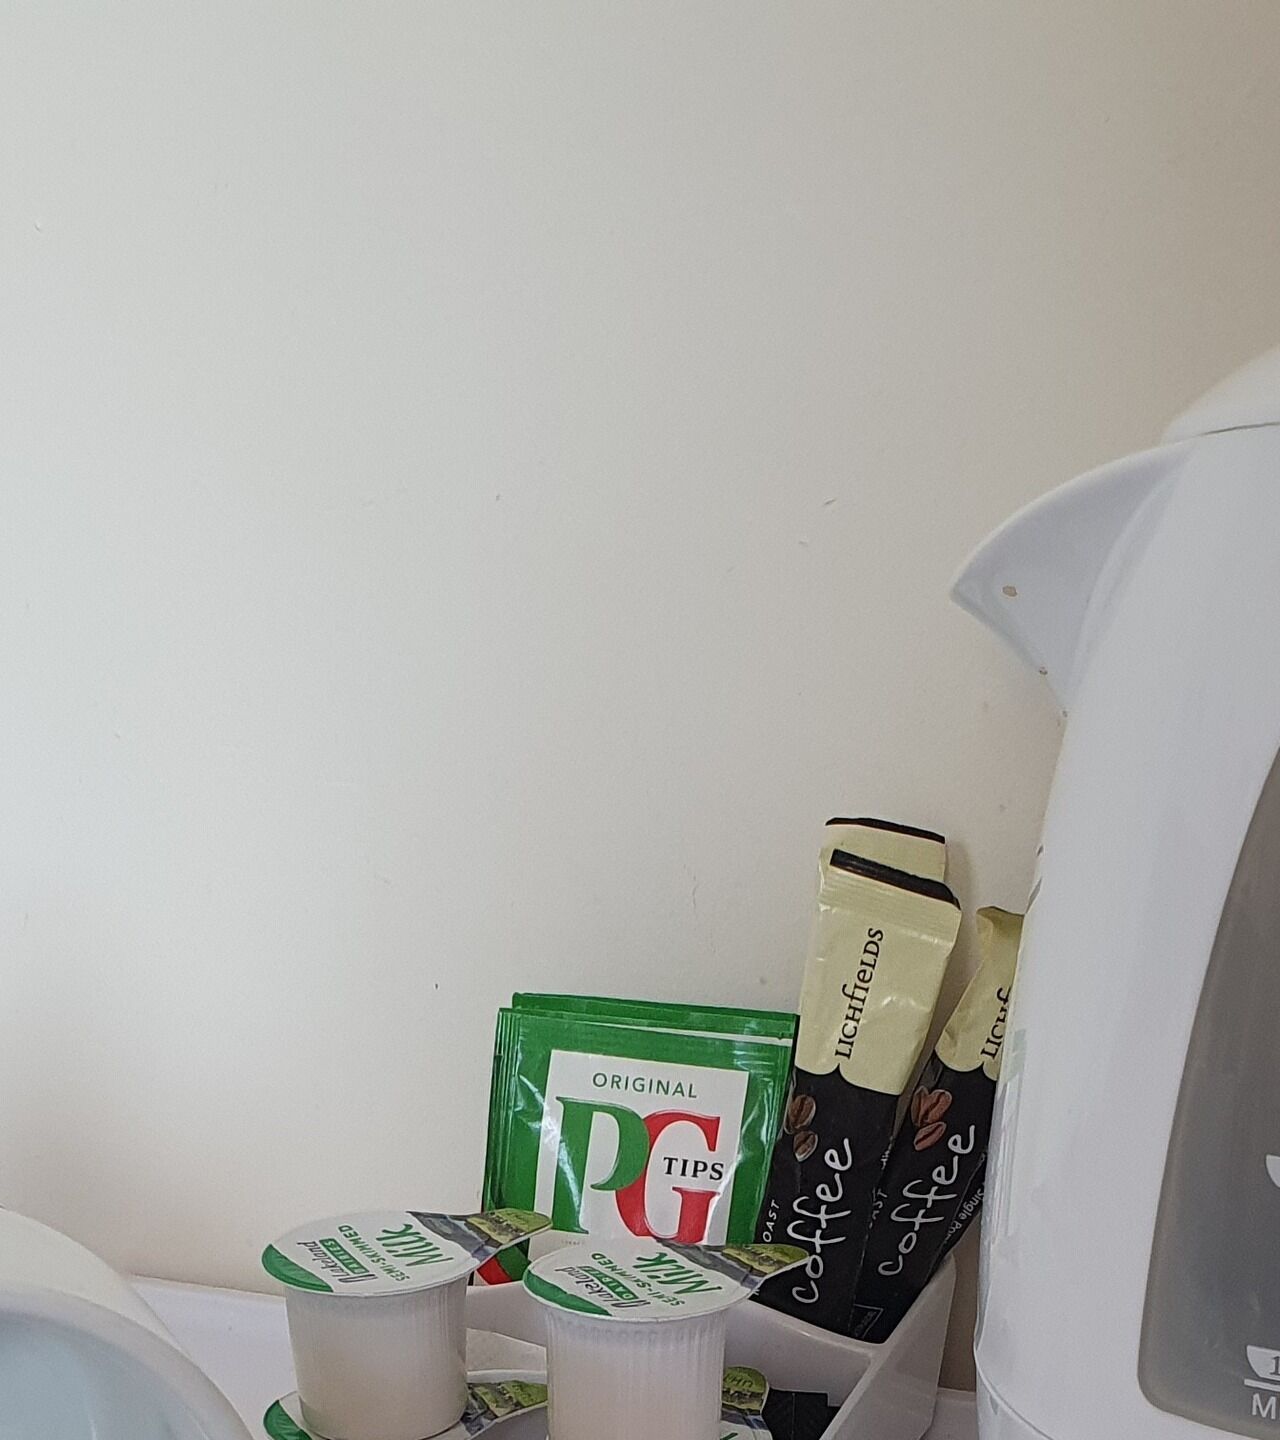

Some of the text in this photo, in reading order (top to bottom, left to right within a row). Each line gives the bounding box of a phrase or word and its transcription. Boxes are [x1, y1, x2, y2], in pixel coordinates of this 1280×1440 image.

[592, 1072, 698, 1100] ORIGINAL
[554, 1097, 721, 1245] PG
[663, 1155, 724, 1182] TIPS
[762, 1199, 778, 1243] OAST
[787, 1137, 854, 1305] coffee
[877, 1124, 976, 1277] coffee
[338, 1224, 411, 1282] SEMI-SKIMMED
[375, 1222, 455, 1267] Milk
[632, 1251, 723, 1295] Milk
